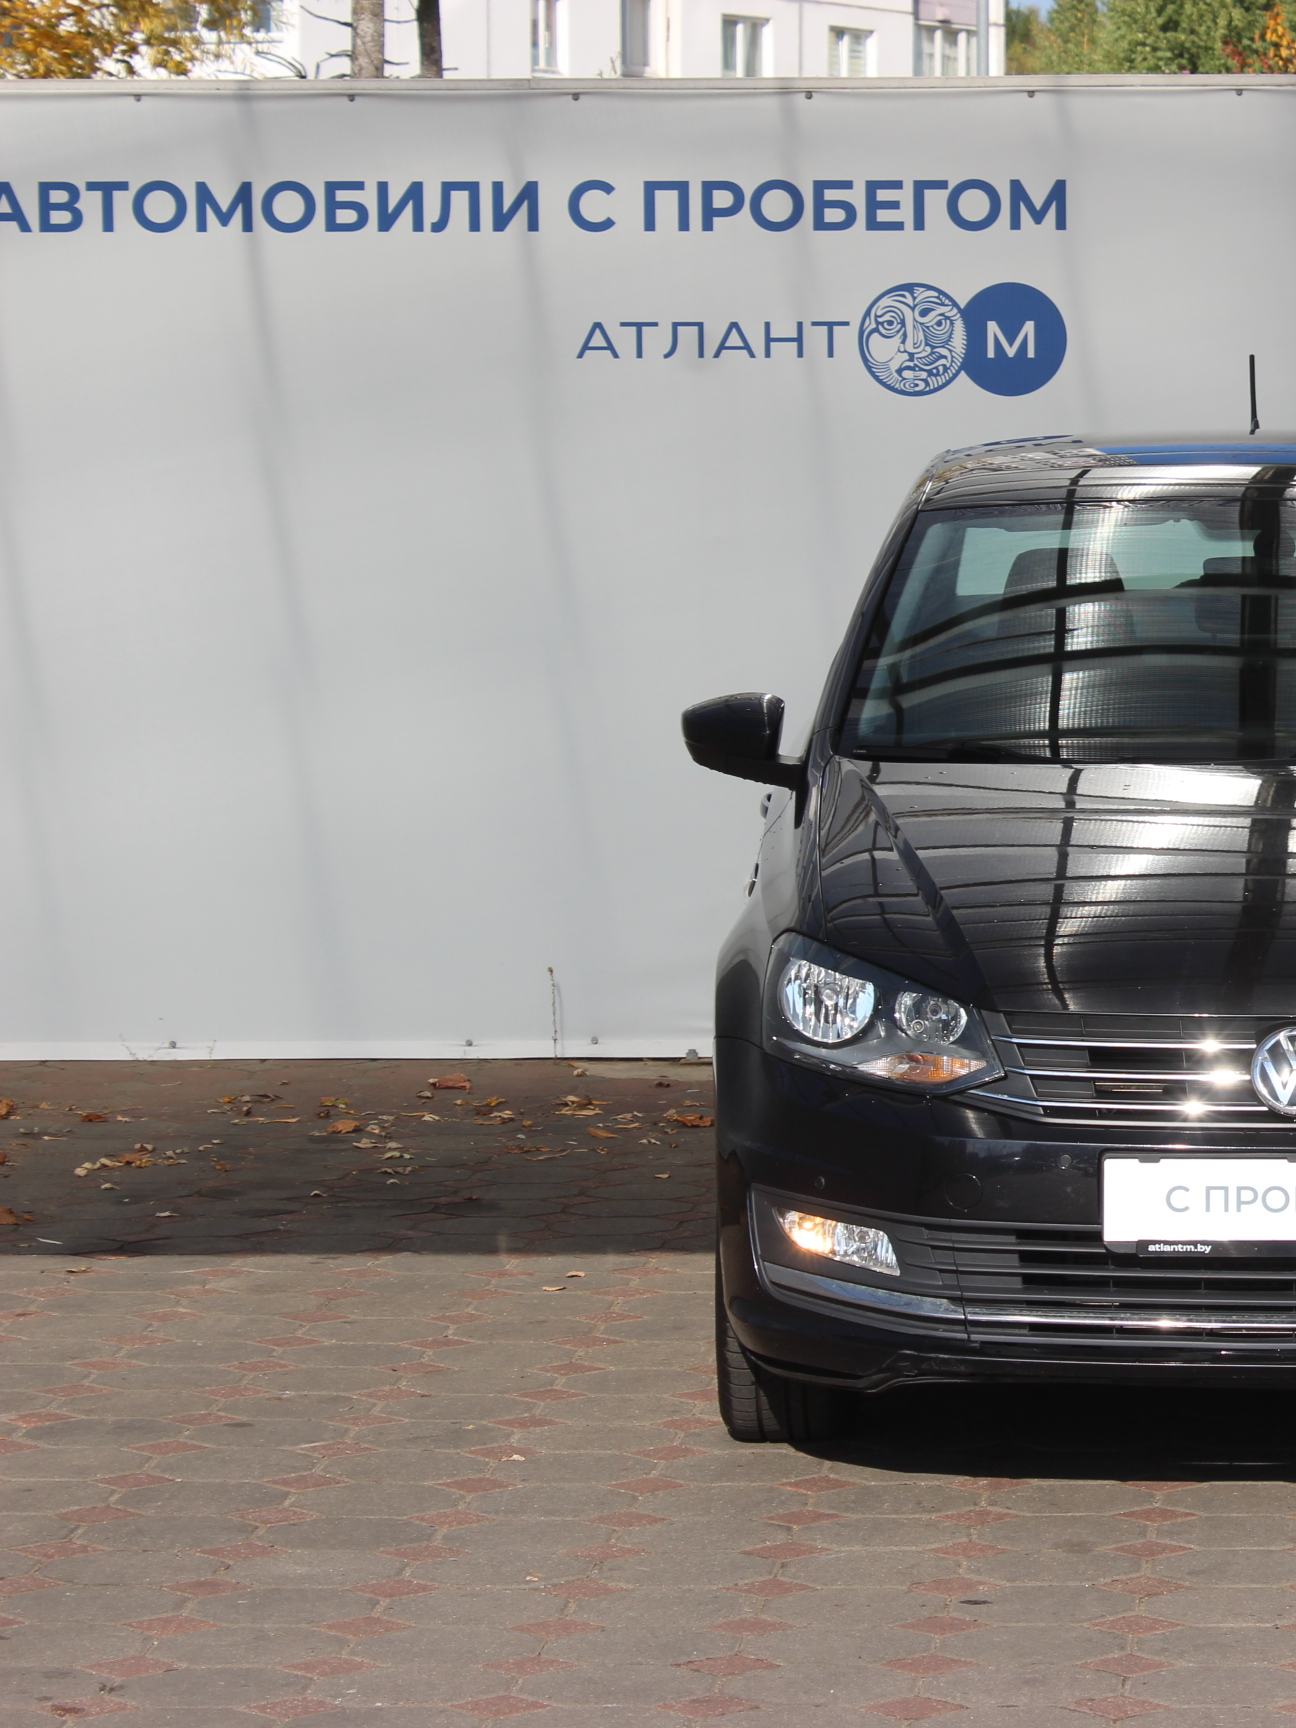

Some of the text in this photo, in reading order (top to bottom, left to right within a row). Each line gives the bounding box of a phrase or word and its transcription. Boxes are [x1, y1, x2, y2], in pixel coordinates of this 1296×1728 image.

[0, 179, 1067, 234] АВТОМОБИЛИ С ПРОБЕГОМ
[576, 320, 1035, 359] АТЛАНТ М
[1165, 1185, 1190, 1213] С
[1147, 1243, 1212, 1254] atlantm.by
